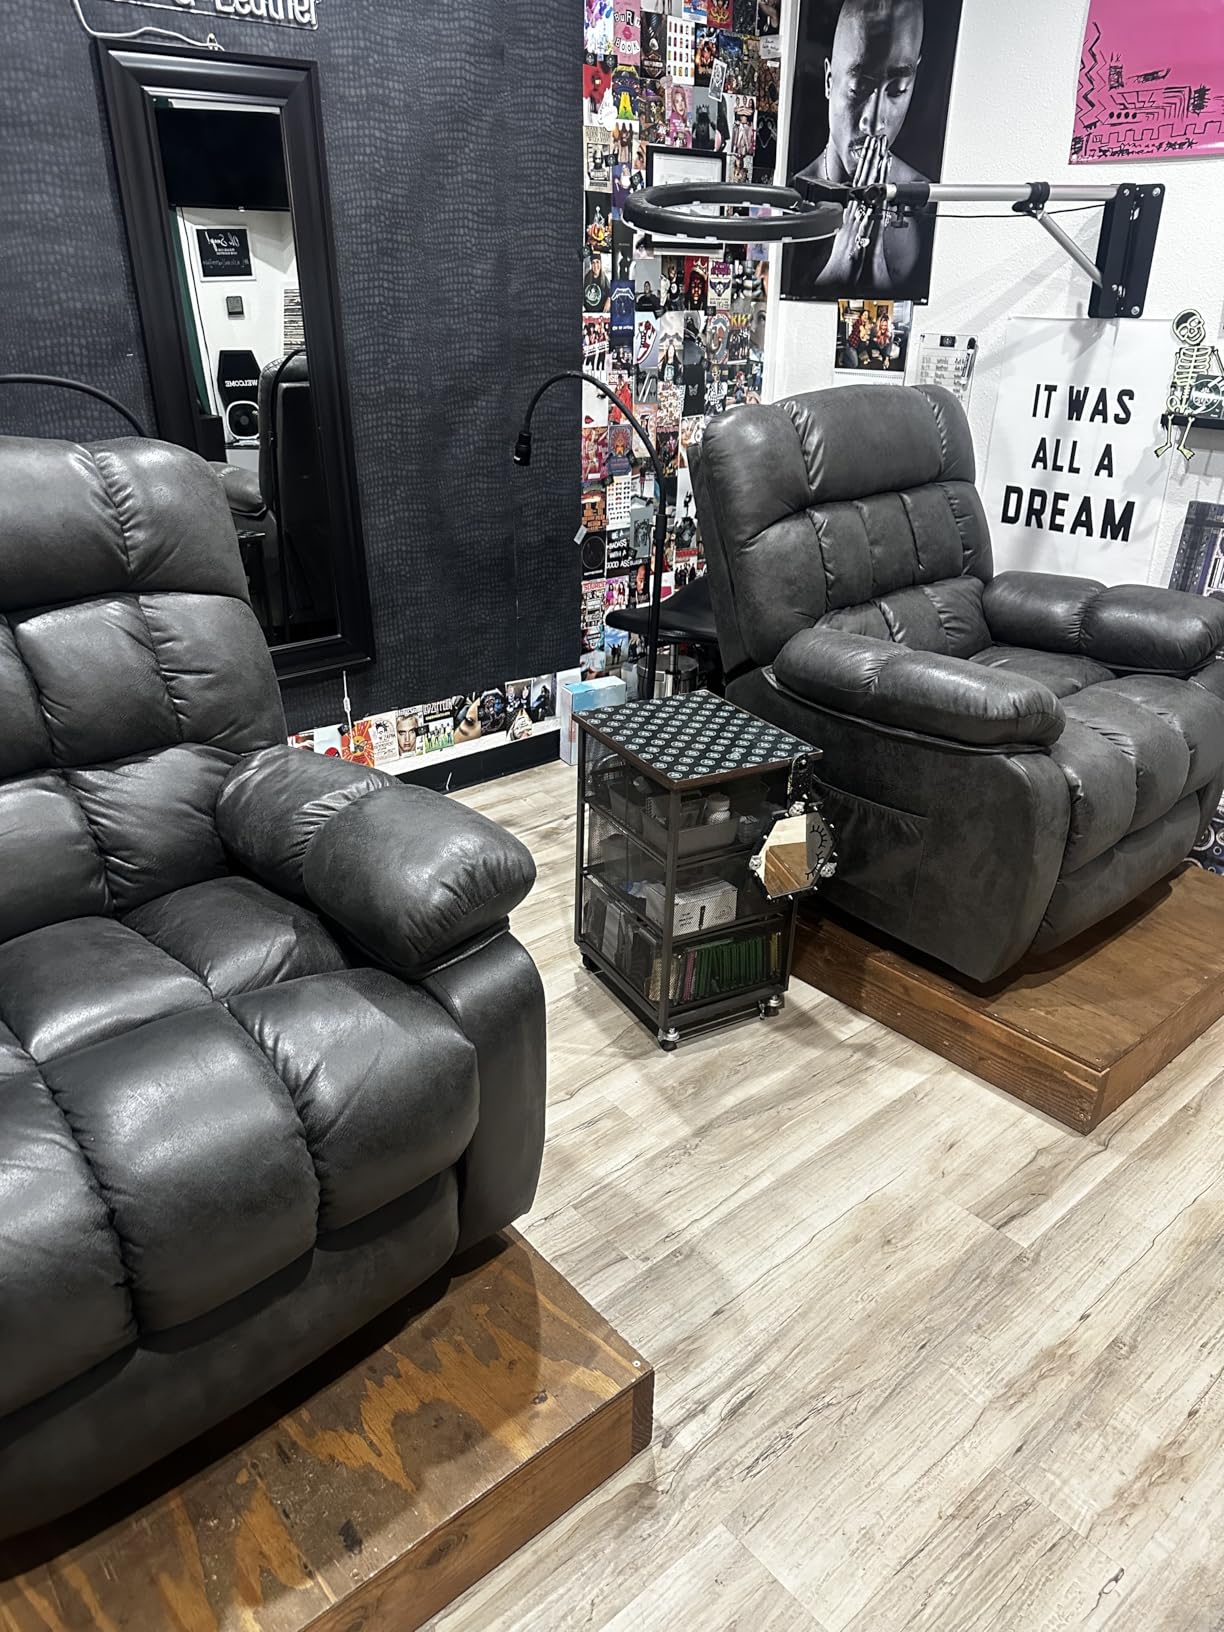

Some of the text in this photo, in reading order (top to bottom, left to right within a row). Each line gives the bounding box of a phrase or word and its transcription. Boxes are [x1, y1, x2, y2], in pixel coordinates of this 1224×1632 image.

[1032, 383, 1135, 425] IT WAS
[1031, 437, 1113, 478] ALL A
[1001, 485, 1135, 542] DREAM
